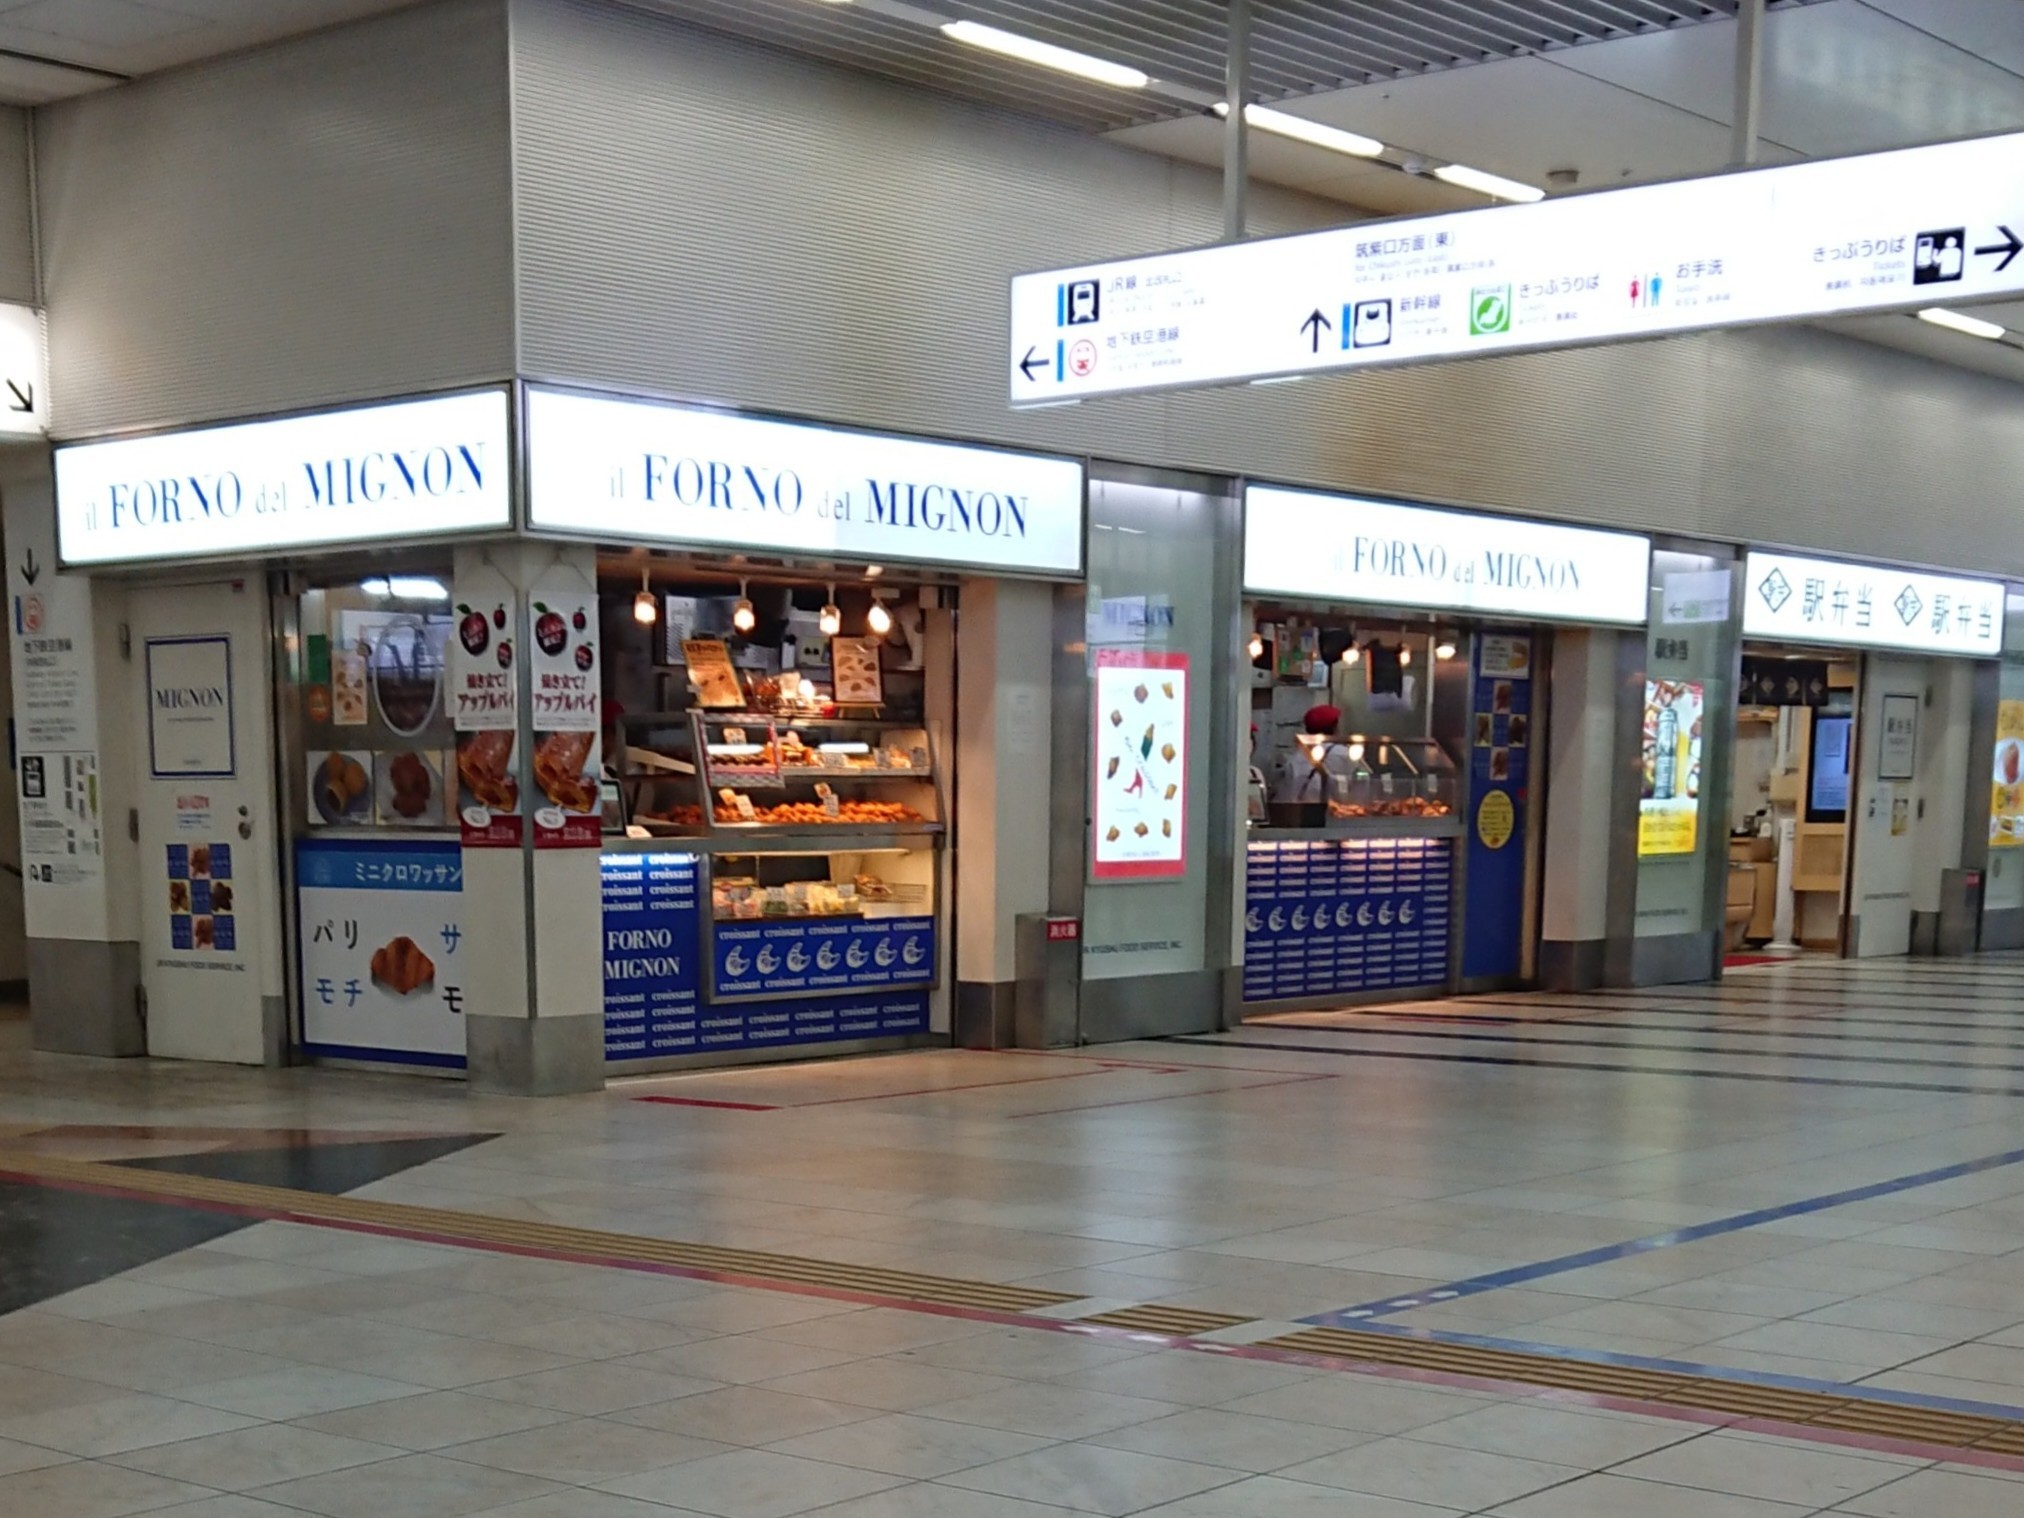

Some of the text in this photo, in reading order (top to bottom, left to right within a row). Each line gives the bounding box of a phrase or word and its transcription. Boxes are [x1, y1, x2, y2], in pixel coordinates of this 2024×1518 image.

[108, 469, 243, 529] FORNO
[254, 480, 288, 515] del
[301, 441, 487, 510] MIGNON
[642, 453, 803, 516] FORNO
[817, 487, 851, 521] del
[864, 478, 1029, 539] MIGNON
[1354, 536, 1447, 581] FORNO
[1483, 550, 1581, 592] MIGNON
[1802, 577, 1873, 627] 駅弁当
[1931, 593, 1992, 639] 駅弁当
[156, 687, 225, 709] MIGNON
[356, 861, 463, 884] ミニクロワッサン
[601, 866, 694, 882] roissant croissant
[602, 882, 695, 897] roissant croissant
[603, 897, 695, 912] roissant croissant
[312, 918, 359, 950] パリ
[607, 928, 673, 952] FORNO
[604, 956, 681, 980] MIGNON
[315, 977, 363, 1008] モチ
[441, 985, 464, 1014] モ
[605, 991, 646, 1005] roissant
[605, 1007, 646, 1021] roissant
[606, 1023, 647, 1037] roissant
[606, 1038, 647, 1053] roissant
